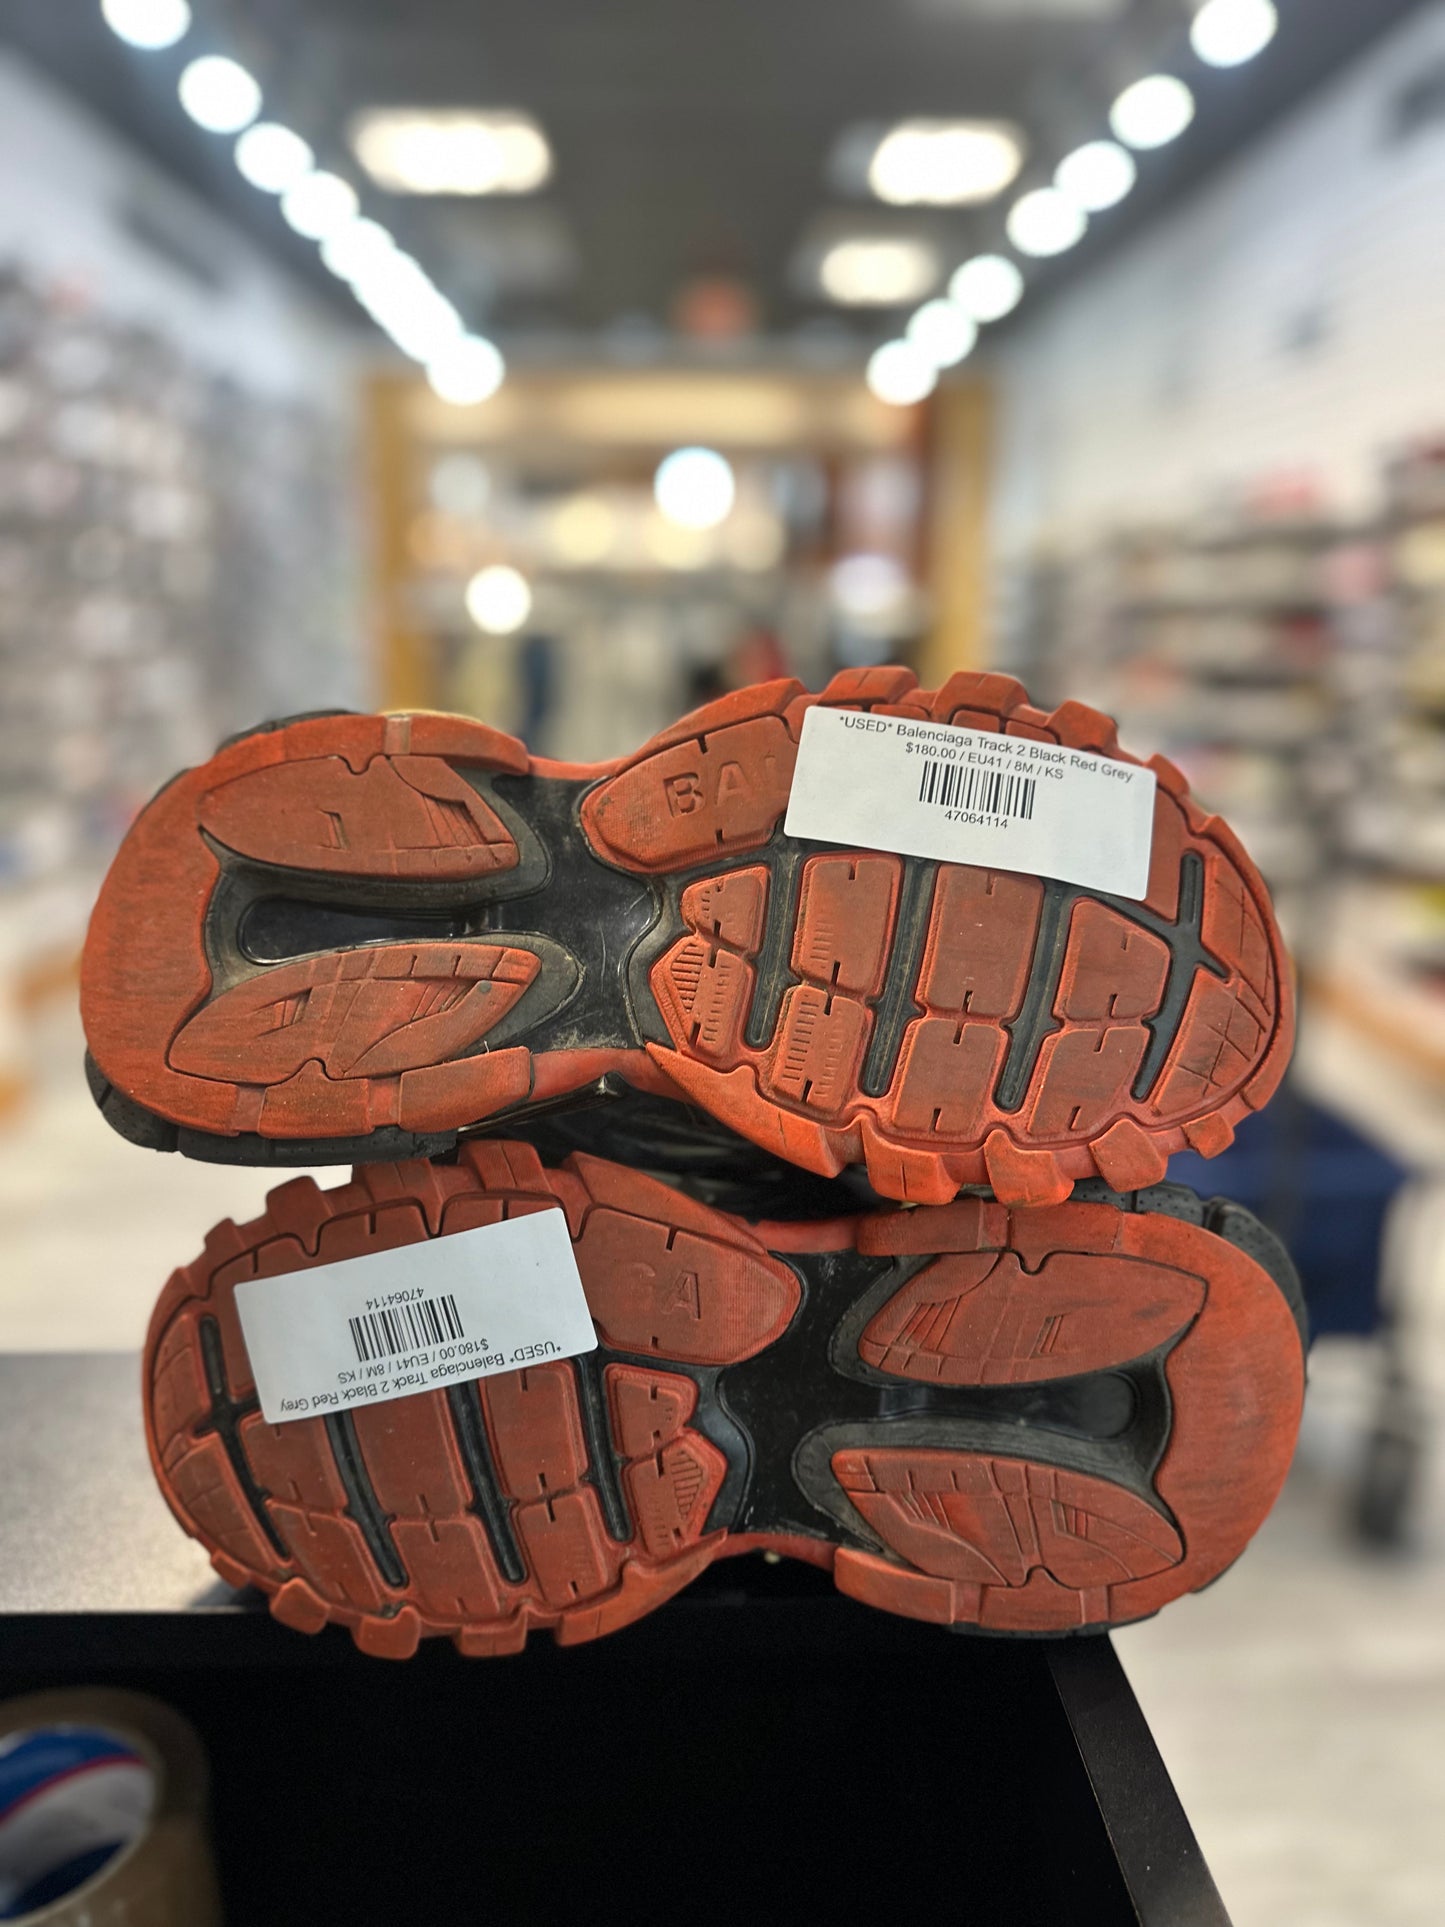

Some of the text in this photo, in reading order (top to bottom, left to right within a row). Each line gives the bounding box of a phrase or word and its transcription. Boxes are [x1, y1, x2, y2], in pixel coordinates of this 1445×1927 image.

[896, 724, 973, 747] Balenciaga
[977, 737, 1013, 754] Track
[1017, 745, 1026, 756] 2
[1030, 747, 1066, 765] Black
[1070, 755, 1098, 772] Red
[1101, 763, 1133, 783] Grey
[905, 742, 957, 760] $180.00
[968, 752, 1002, 768] EU41
[1014, 761, 1033, 773] 8M
[1045, 766, 1064, 780] KS
[944, 810, 1008, 829] 47064114
[365, 1287, 424, 1311] 47064114
[439, 1338, 489, 1360] $180.00
[366, 1363, 385, 1378] 8M
[396, 1353, 430, 1371] EU41
[430, 1352, 505, 1379] Balenciaga
[337, 1370, 357, 1385] KS
[393, 1371, 428, 1390] Track
[341, 1383, 378, 1401] Black
[380, 1381, 390, 1393] 2
[280, 1398, 309, 1412] Grey
[312, 1391, 339, 1408] Red
